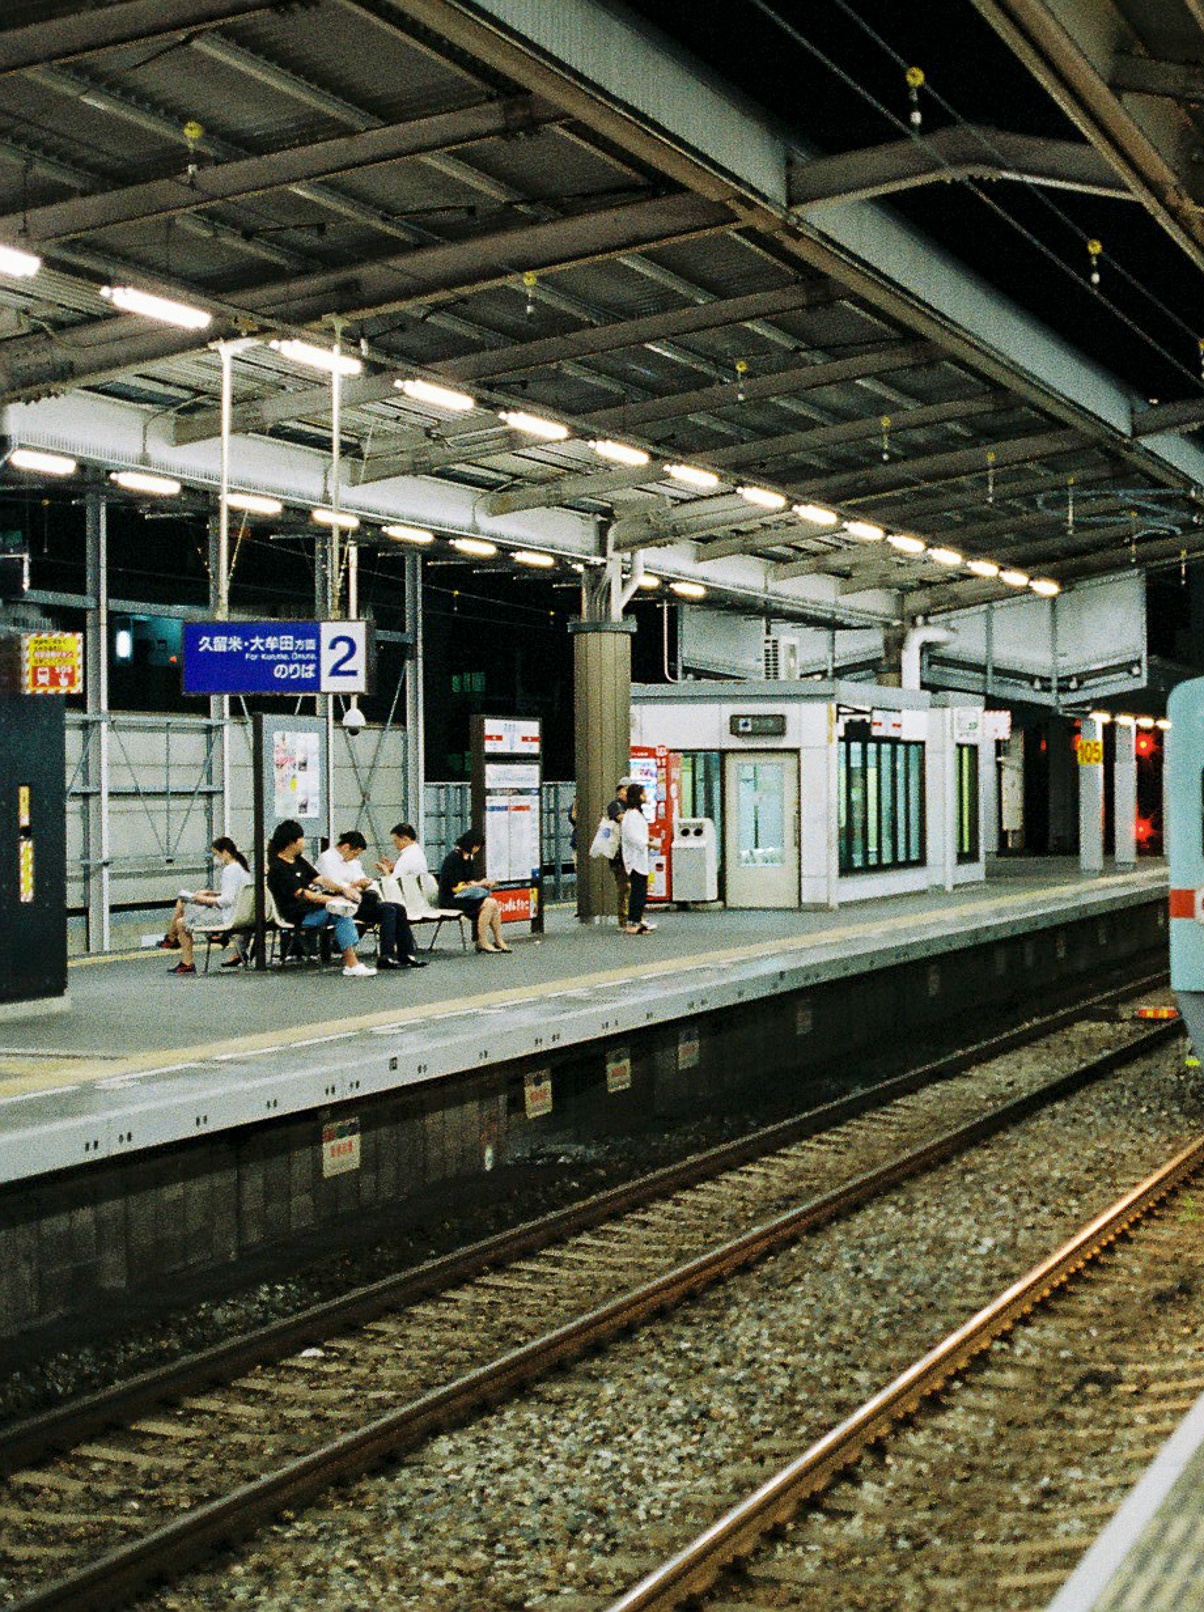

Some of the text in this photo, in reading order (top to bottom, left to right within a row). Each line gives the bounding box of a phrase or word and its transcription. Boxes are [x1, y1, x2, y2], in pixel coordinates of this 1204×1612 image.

[198, 635, 317, 653] 久留米・大牟田方面
[327, 635, 359, 677] 2
[273, 664, 316, 679] のりば
